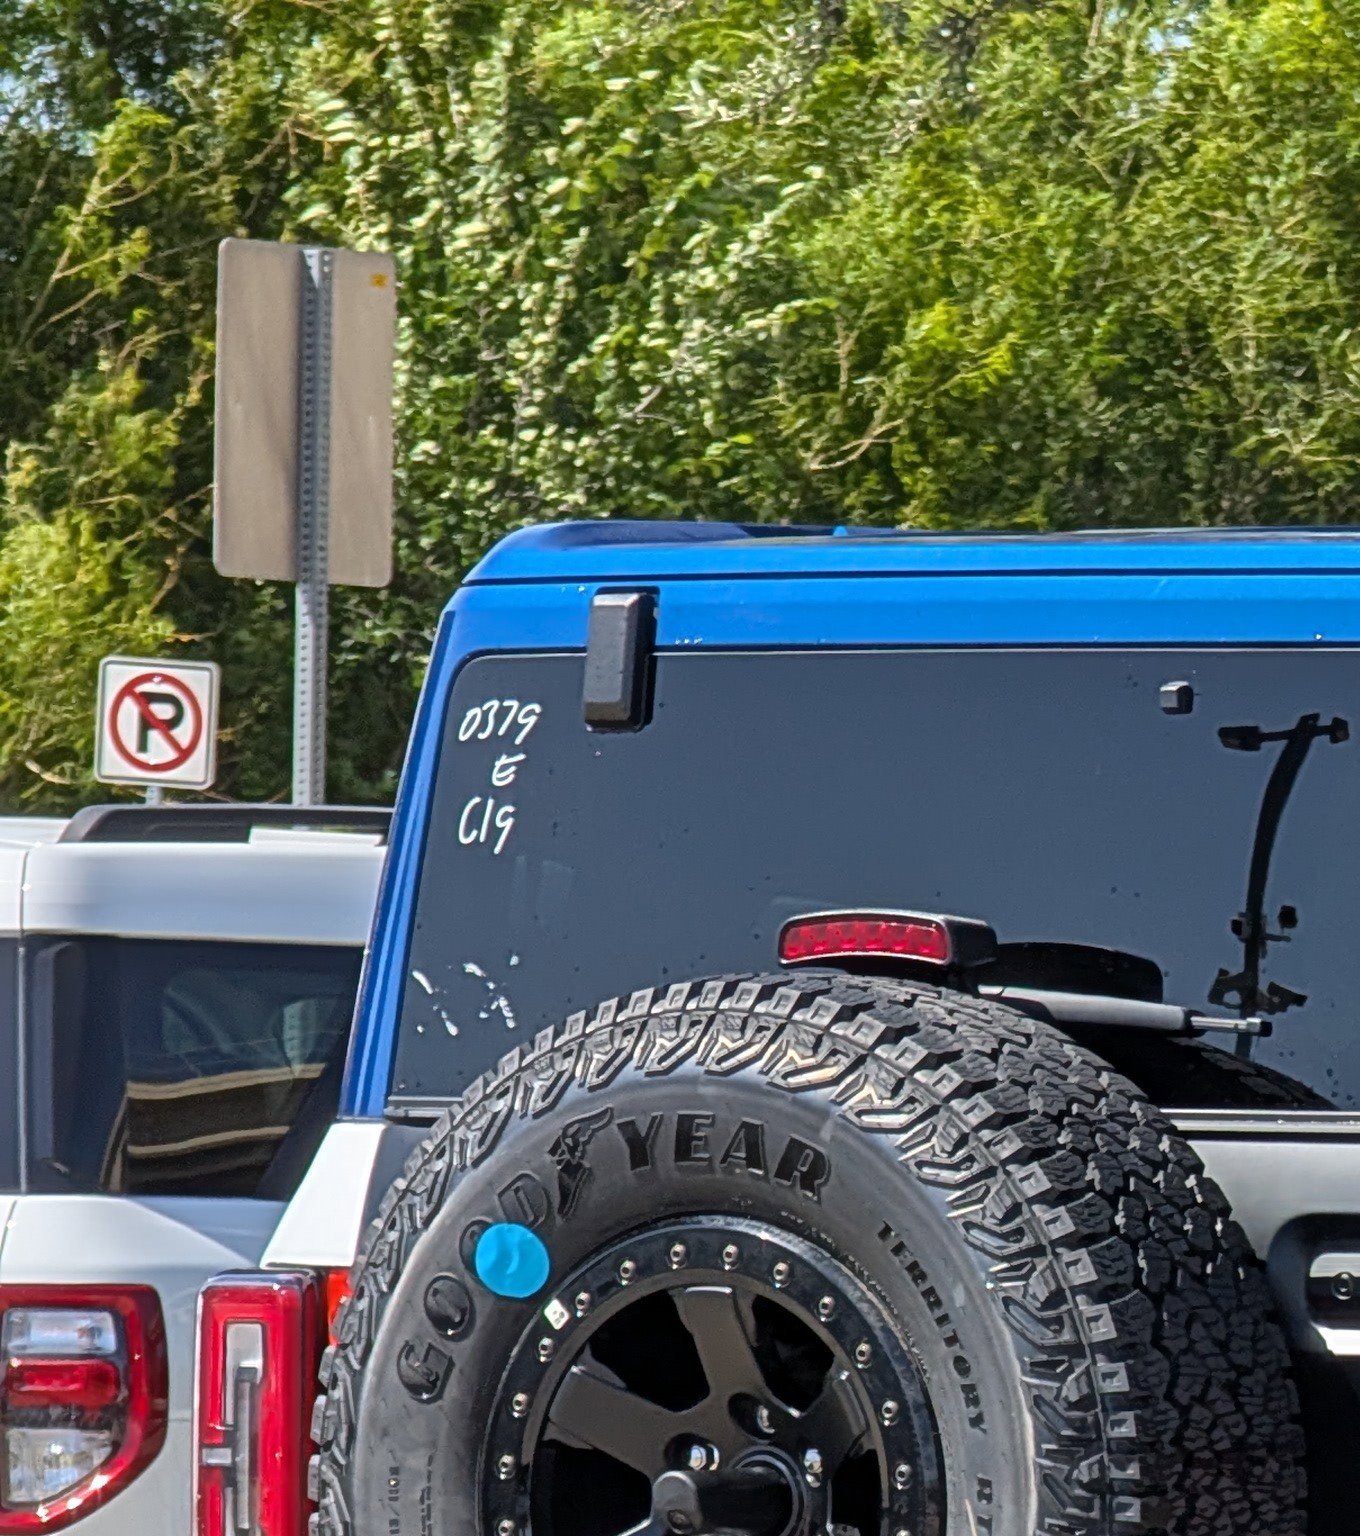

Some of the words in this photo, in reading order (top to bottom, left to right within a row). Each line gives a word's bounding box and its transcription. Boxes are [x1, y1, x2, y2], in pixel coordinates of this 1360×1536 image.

[137, 691, 184, 753] P
[458, 700, 541, 745] 0379
[458, 796, 516, 854] C19
[878, 1220, 988, 1434] TERRITORY
